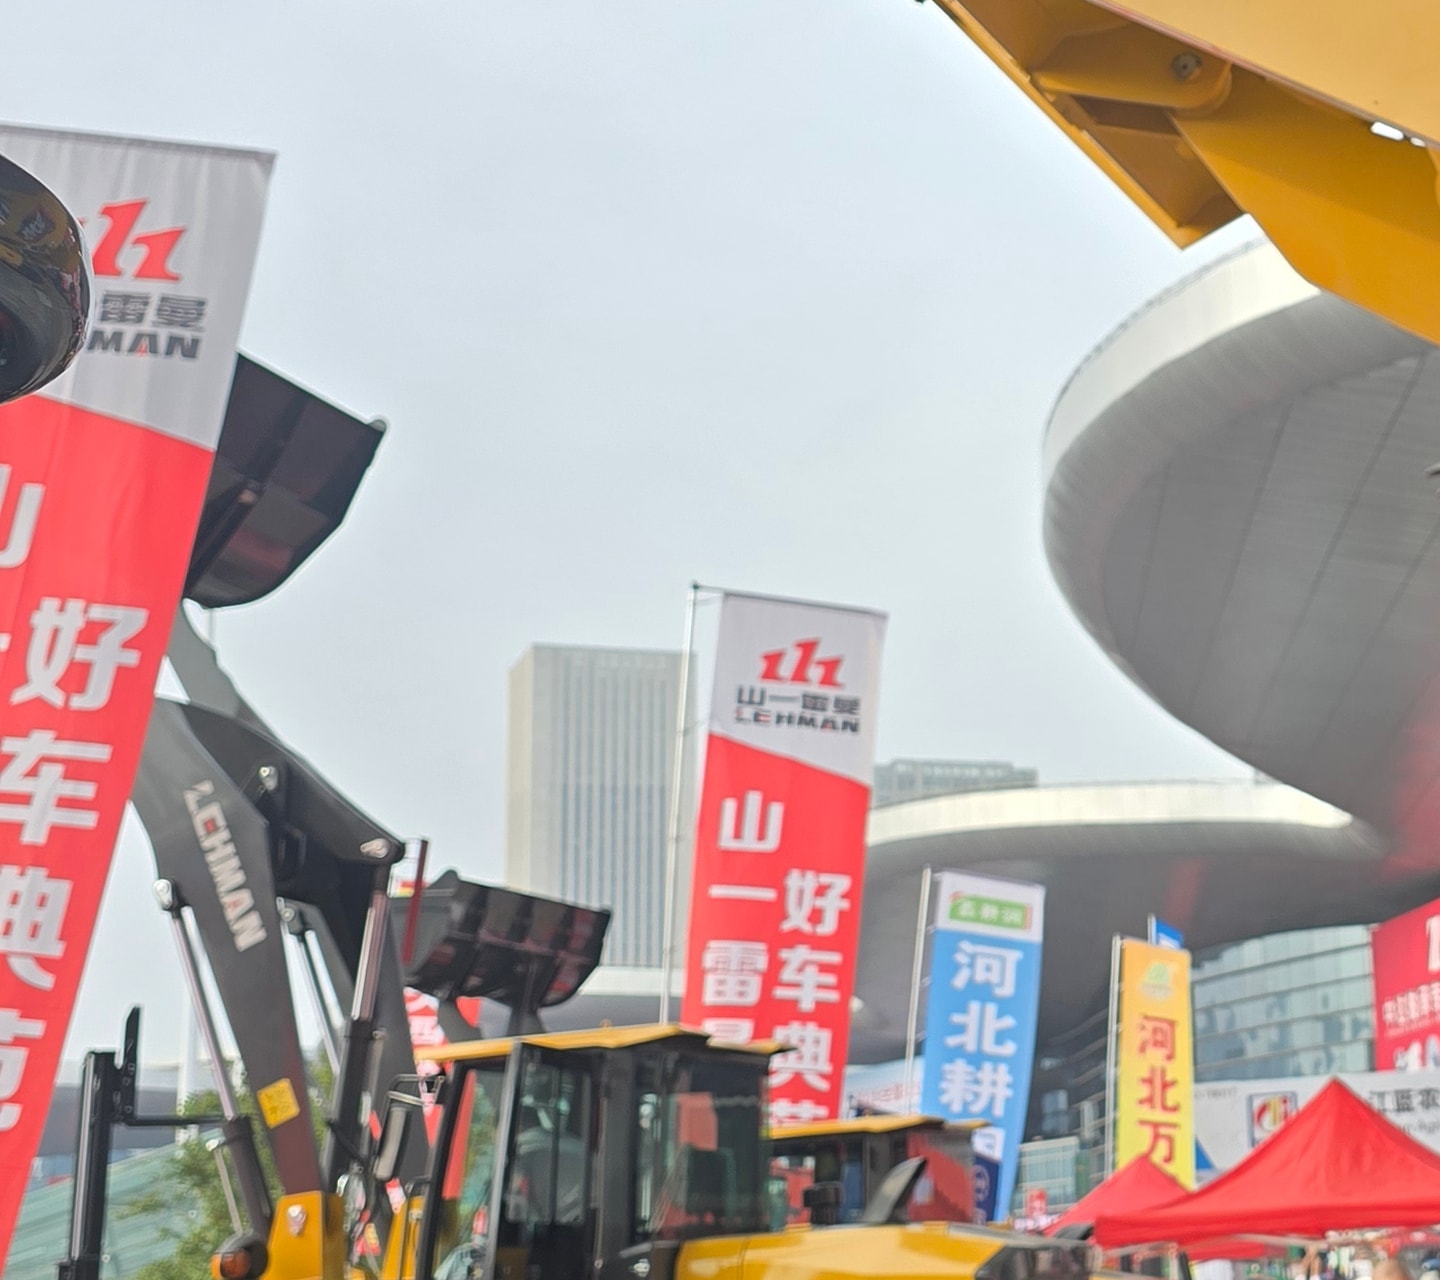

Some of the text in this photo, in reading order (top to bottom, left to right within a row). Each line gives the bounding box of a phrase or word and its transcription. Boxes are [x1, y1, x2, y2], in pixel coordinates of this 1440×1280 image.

[100, 291, 206, 332] 雷曼
[86, 329, 200, 360] MAN
[735, 707, 860, 733] LEHMAN
[183, 779, 268, 952] LEHMAN
